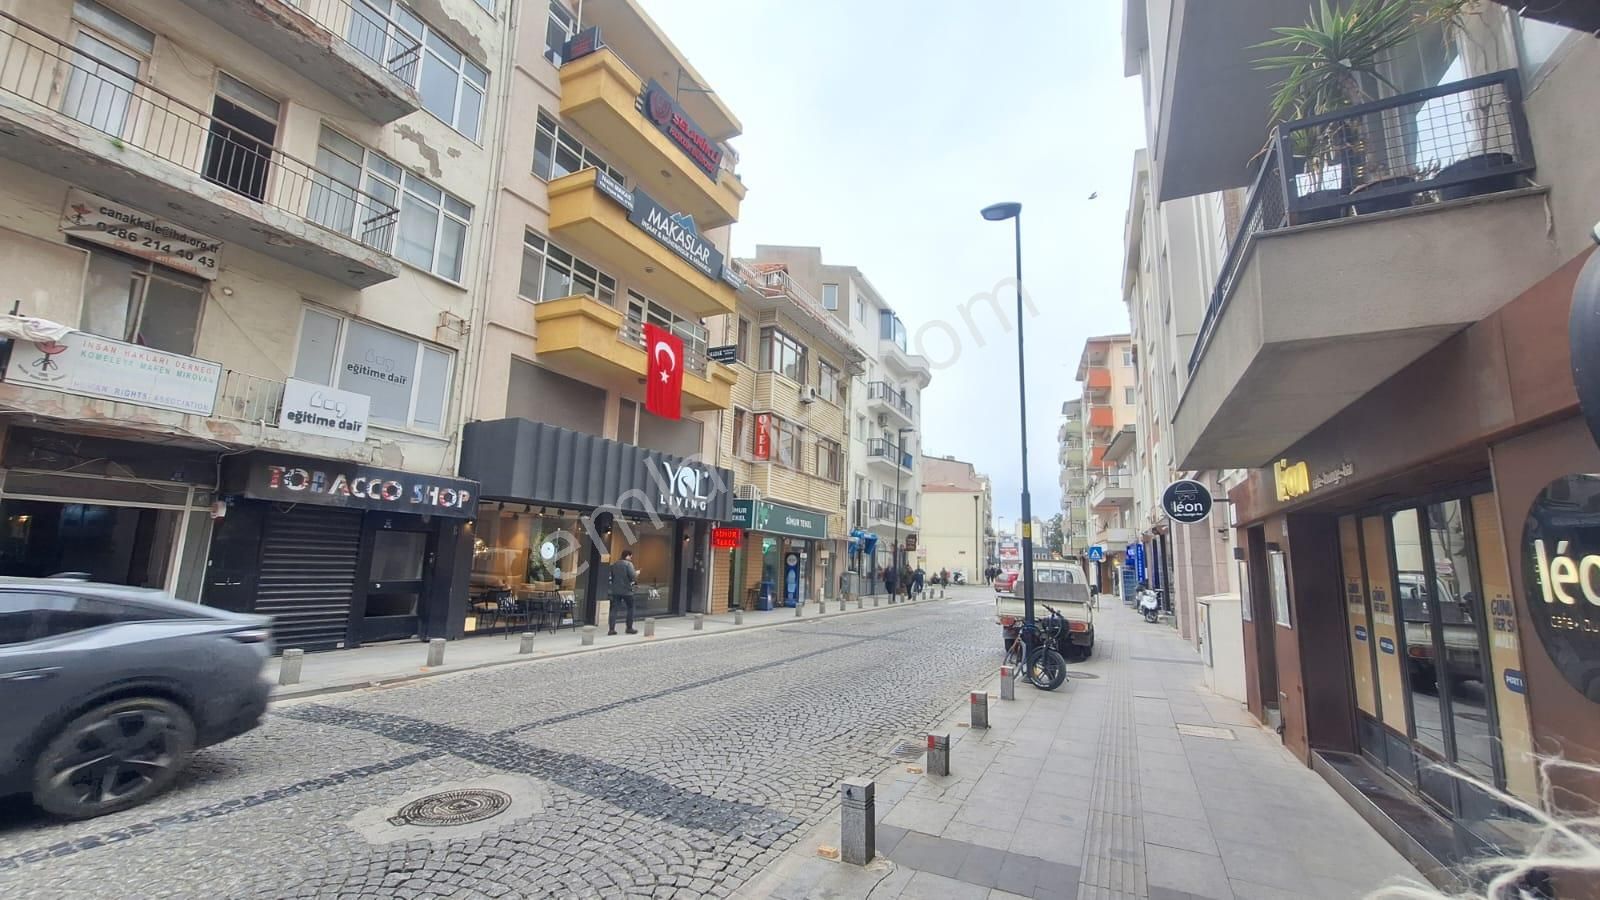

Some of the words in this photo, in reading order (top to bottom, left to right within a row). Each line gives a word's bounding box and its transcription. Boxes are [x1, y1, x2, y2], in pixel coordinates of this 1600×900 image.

[96, 221, 138, 243] 0286
[142, 236, 171, 255] 214
[175, 248, 194, 262] 40
[198, 255, 216, 269] 43
[648, 207, 710, 265] MAKASLAR
[346, 362, 386, 380] eğitime
[387, 372, 408, 386] dair
[287, 410, 336, 429] eğitime
[338, 419, 363, 432] dair
[758, 414, 767, 456] OTEL
[268, 465, 403, 502] TOBACCO
[410, 484, 471, 509] SHOP
[660, 493, 707, 511] LIVING
[1172, 500, 1203, 513] léon
